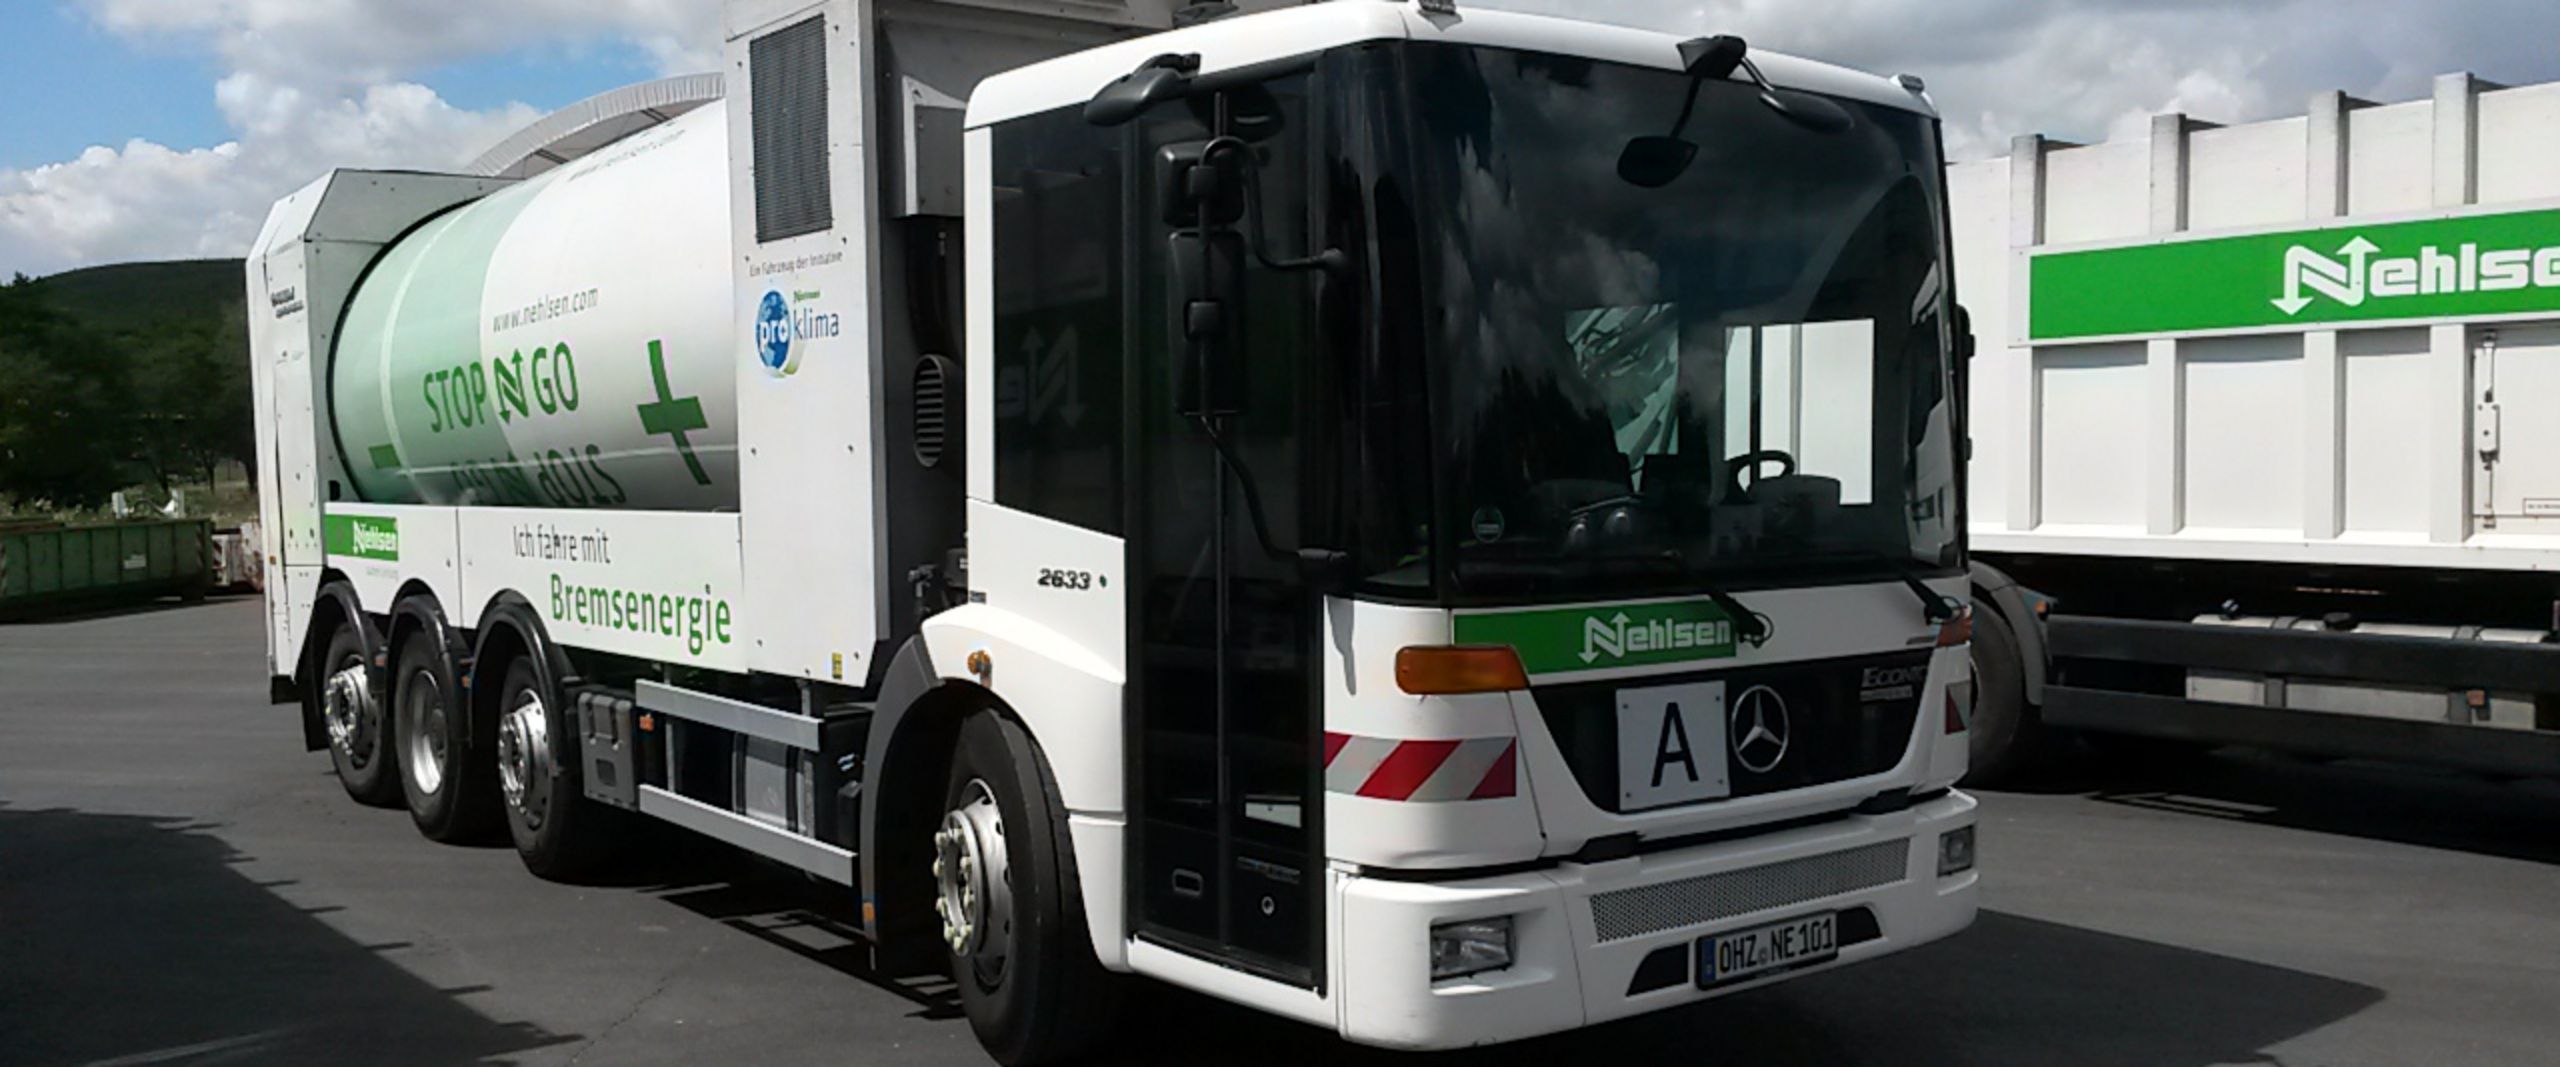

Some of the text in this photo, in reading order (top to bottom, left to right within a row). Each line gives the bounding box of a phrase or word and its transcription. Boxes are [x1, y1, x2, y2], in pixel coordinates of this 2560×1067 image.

[493, 288, 599, 333] www.nehlsen.com
[793, 307, 839, 340] klima
[757, 320, 789, 351] pro
[423, 361, 487, 433] STOP
[531, 341, 579, 416] GO
[352, 519, 398, 554] Nehlsen
[512, 523, 611, 564] Ich fahre mit
[1037, 567, 1092, 591] 2633
[549, 573, 732, 656] Bremsenergie
[1577, 611, 1732, 664] Nehlsen
[1651, 701, 1699, 787] A
[1719, 917, 1833, 974] OHZ NE 101
